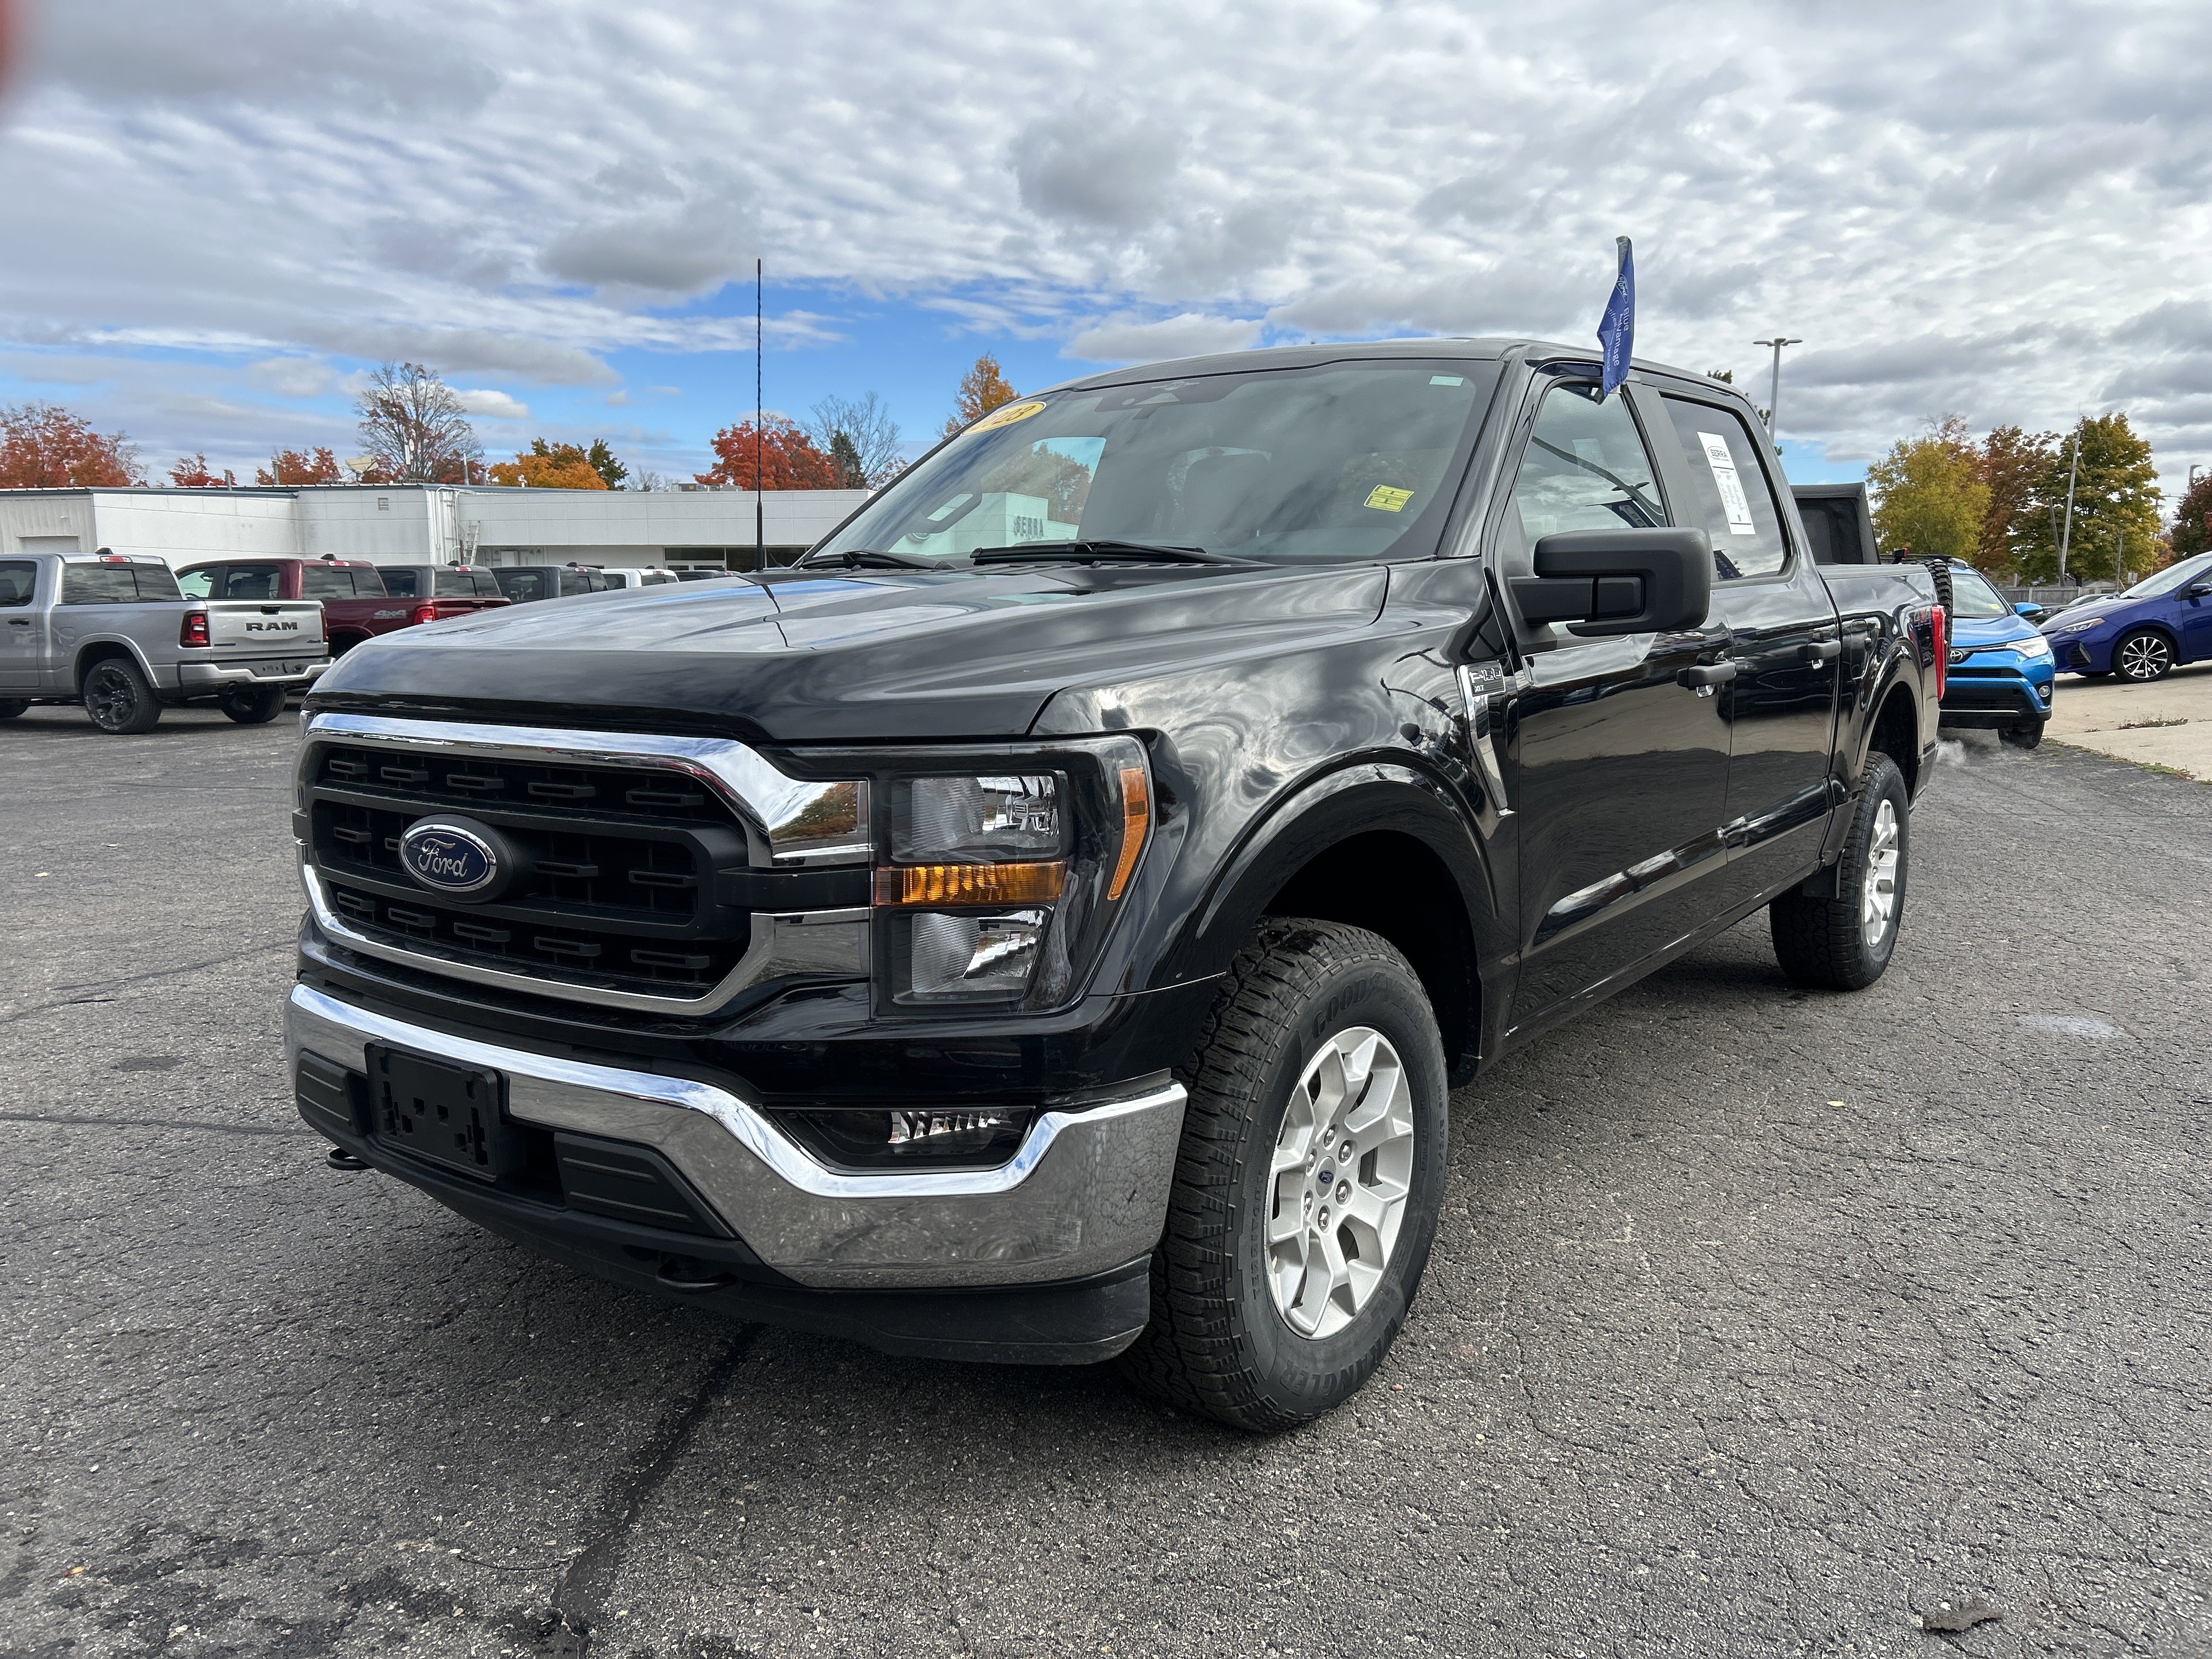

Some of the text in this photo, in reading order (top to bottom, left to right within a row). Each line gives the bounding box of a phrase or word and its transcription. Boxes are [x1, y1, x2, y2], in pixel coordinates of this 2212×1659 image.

[1015, 516, 1045, 537] SERRA
[245, 622, 298, 631] RAM
[417, 838, 469, 878] Ford
[1279, 1317, 1398, 1400] WRANGLER
